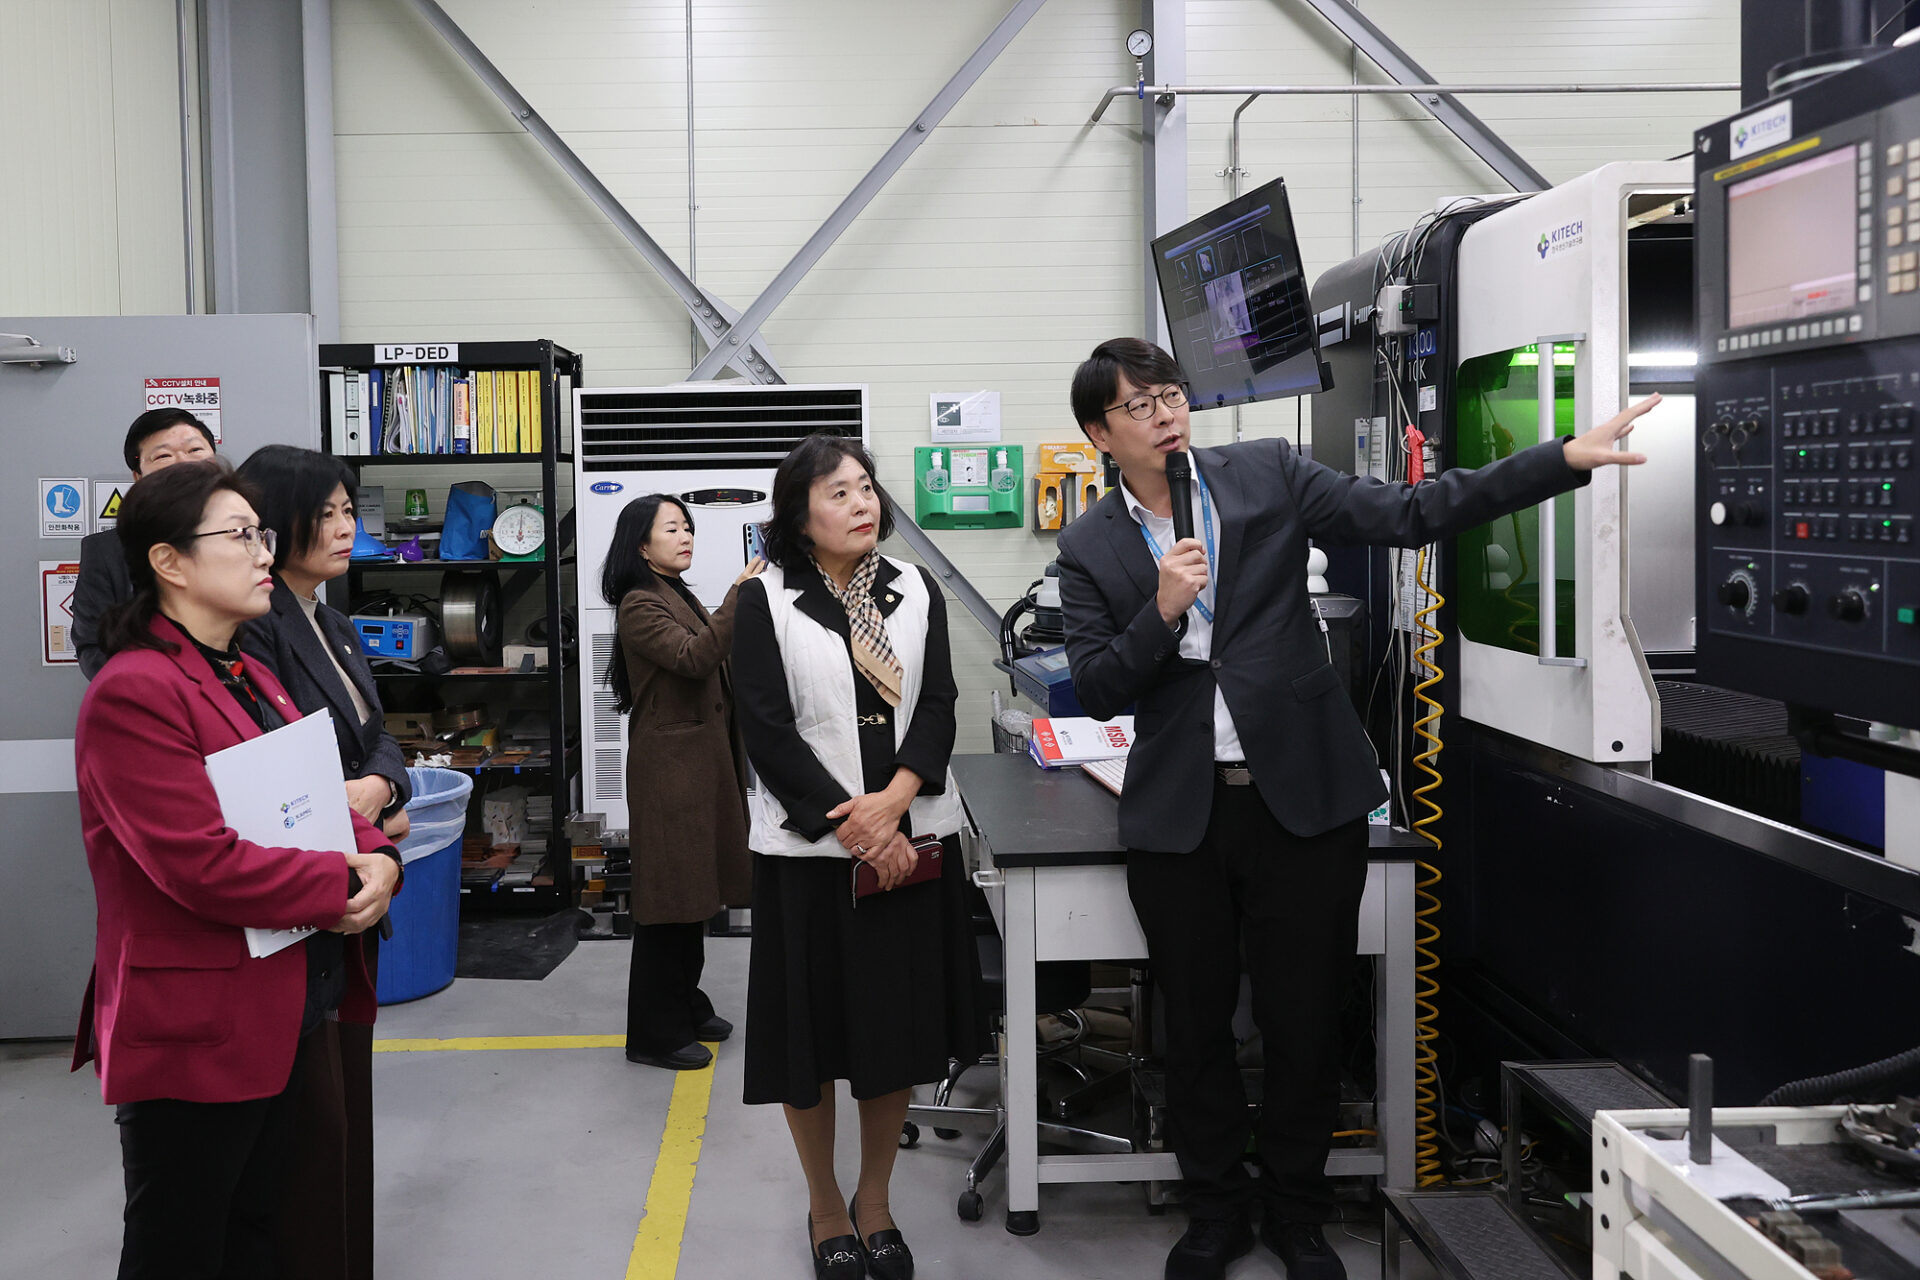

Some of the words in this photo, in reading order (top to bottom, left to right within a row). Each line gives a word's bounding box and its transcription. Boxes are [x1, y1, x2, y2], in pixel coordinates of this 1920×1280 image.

[1751, 114, 1786, 135] KITECH
[1551, 220, 1583, 243] KITECH
[384, 346, 449, 360] LP-DED
[147, 392, 219, 405] CCTV녹화중
[1104, 726, 1130, 748] MSDS
